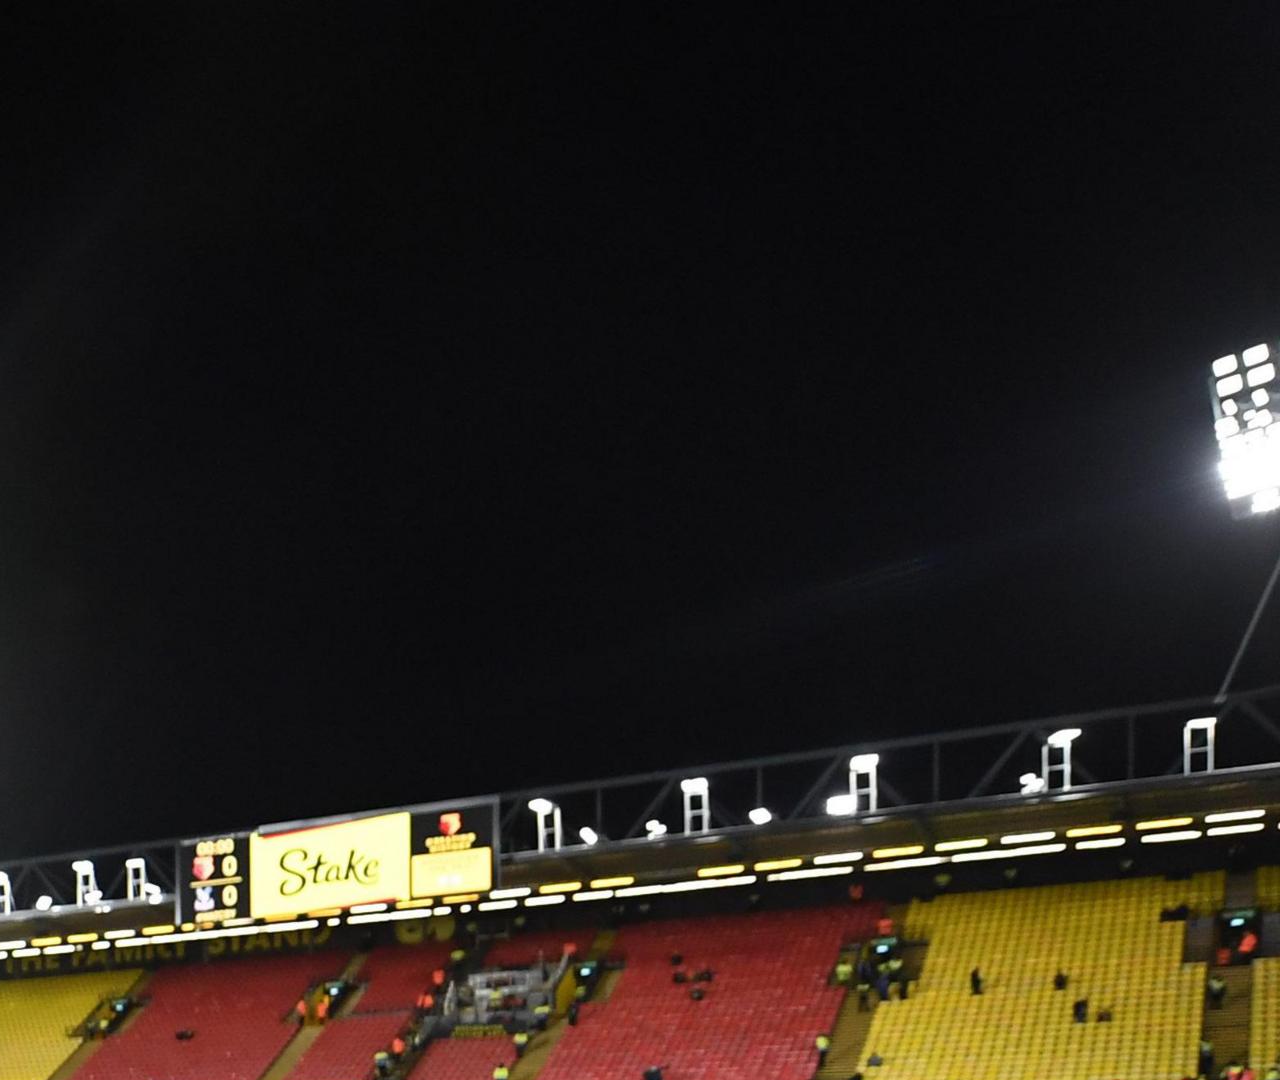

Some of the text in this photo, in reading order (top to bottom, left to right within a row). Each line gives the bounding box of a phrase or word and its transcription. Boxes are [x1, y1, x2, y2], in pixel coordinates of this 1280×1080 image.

[222, 855, 238, 877] 0
[278, 848, 381, 896] Stake
[222, 885, 238, 907] 0
